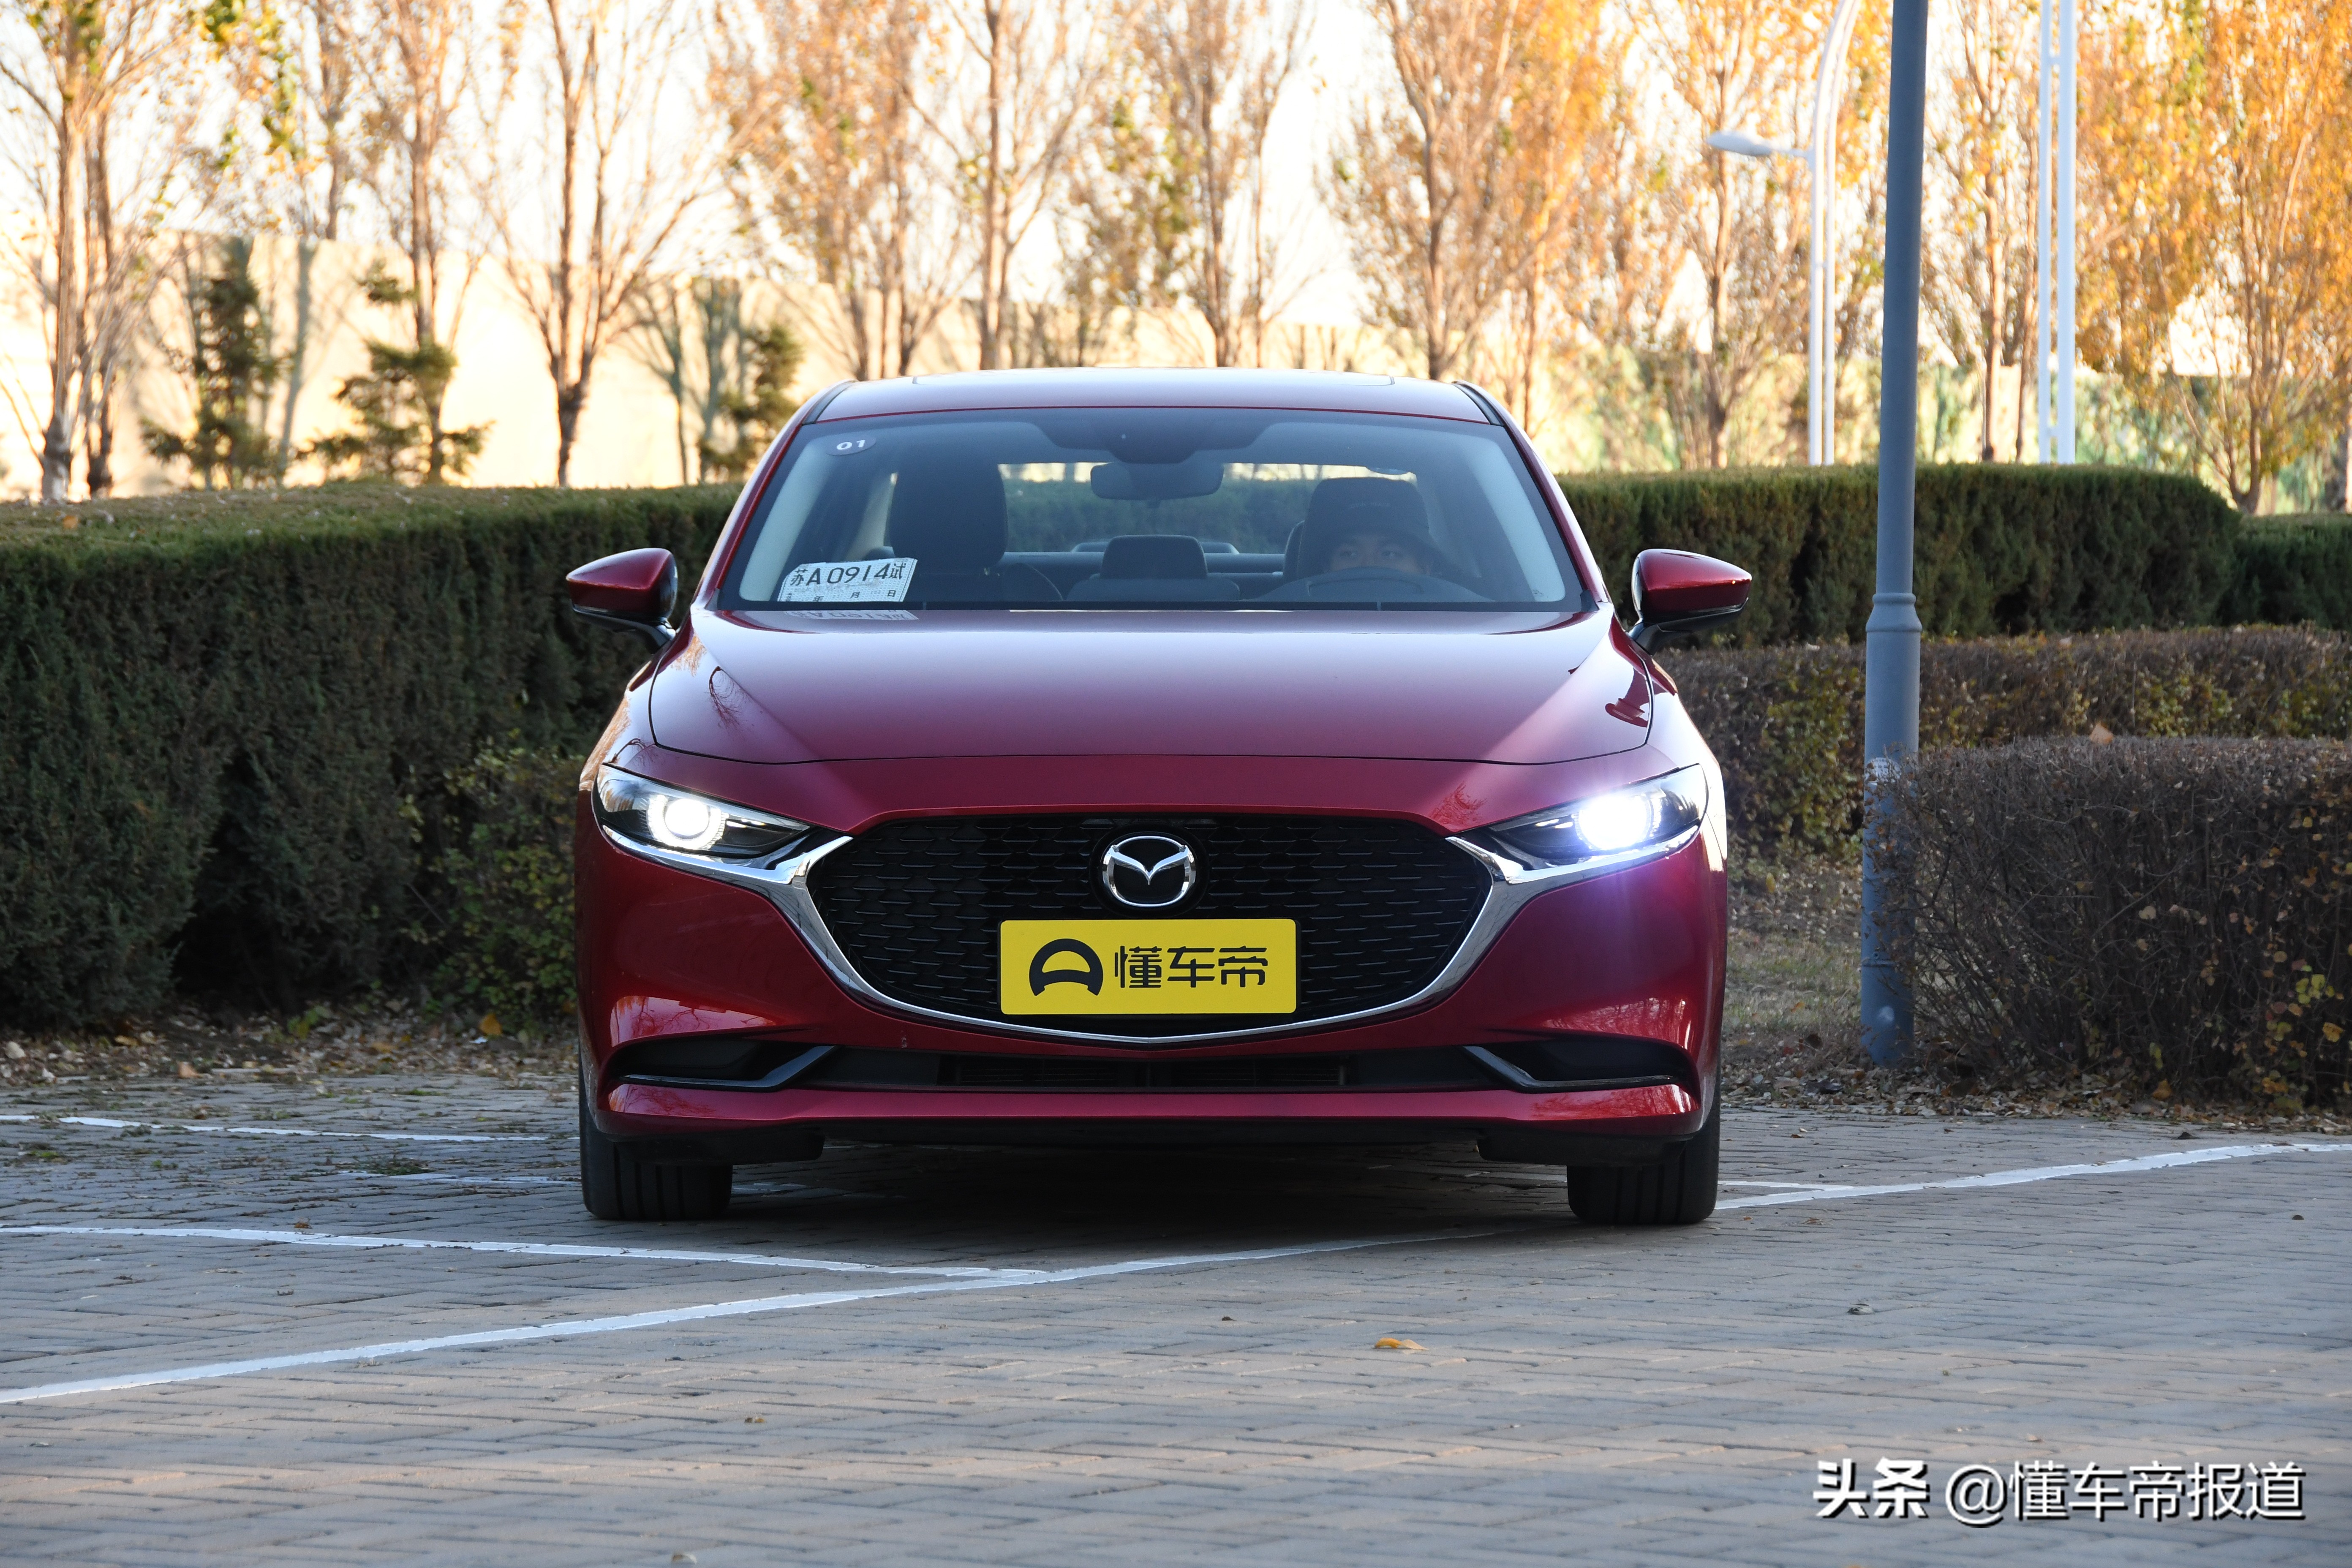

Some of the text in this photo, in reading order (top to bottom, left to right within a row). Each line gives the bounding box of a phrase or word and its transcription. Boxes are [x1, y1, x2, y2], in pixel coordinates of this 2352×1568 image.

[836, 440, 866, 450] 01
[790, 562, 906, 586] 苏A0914试
[887, 589, 896, 597] 日
[1114, 946, 1268, 988] 懂车帝
